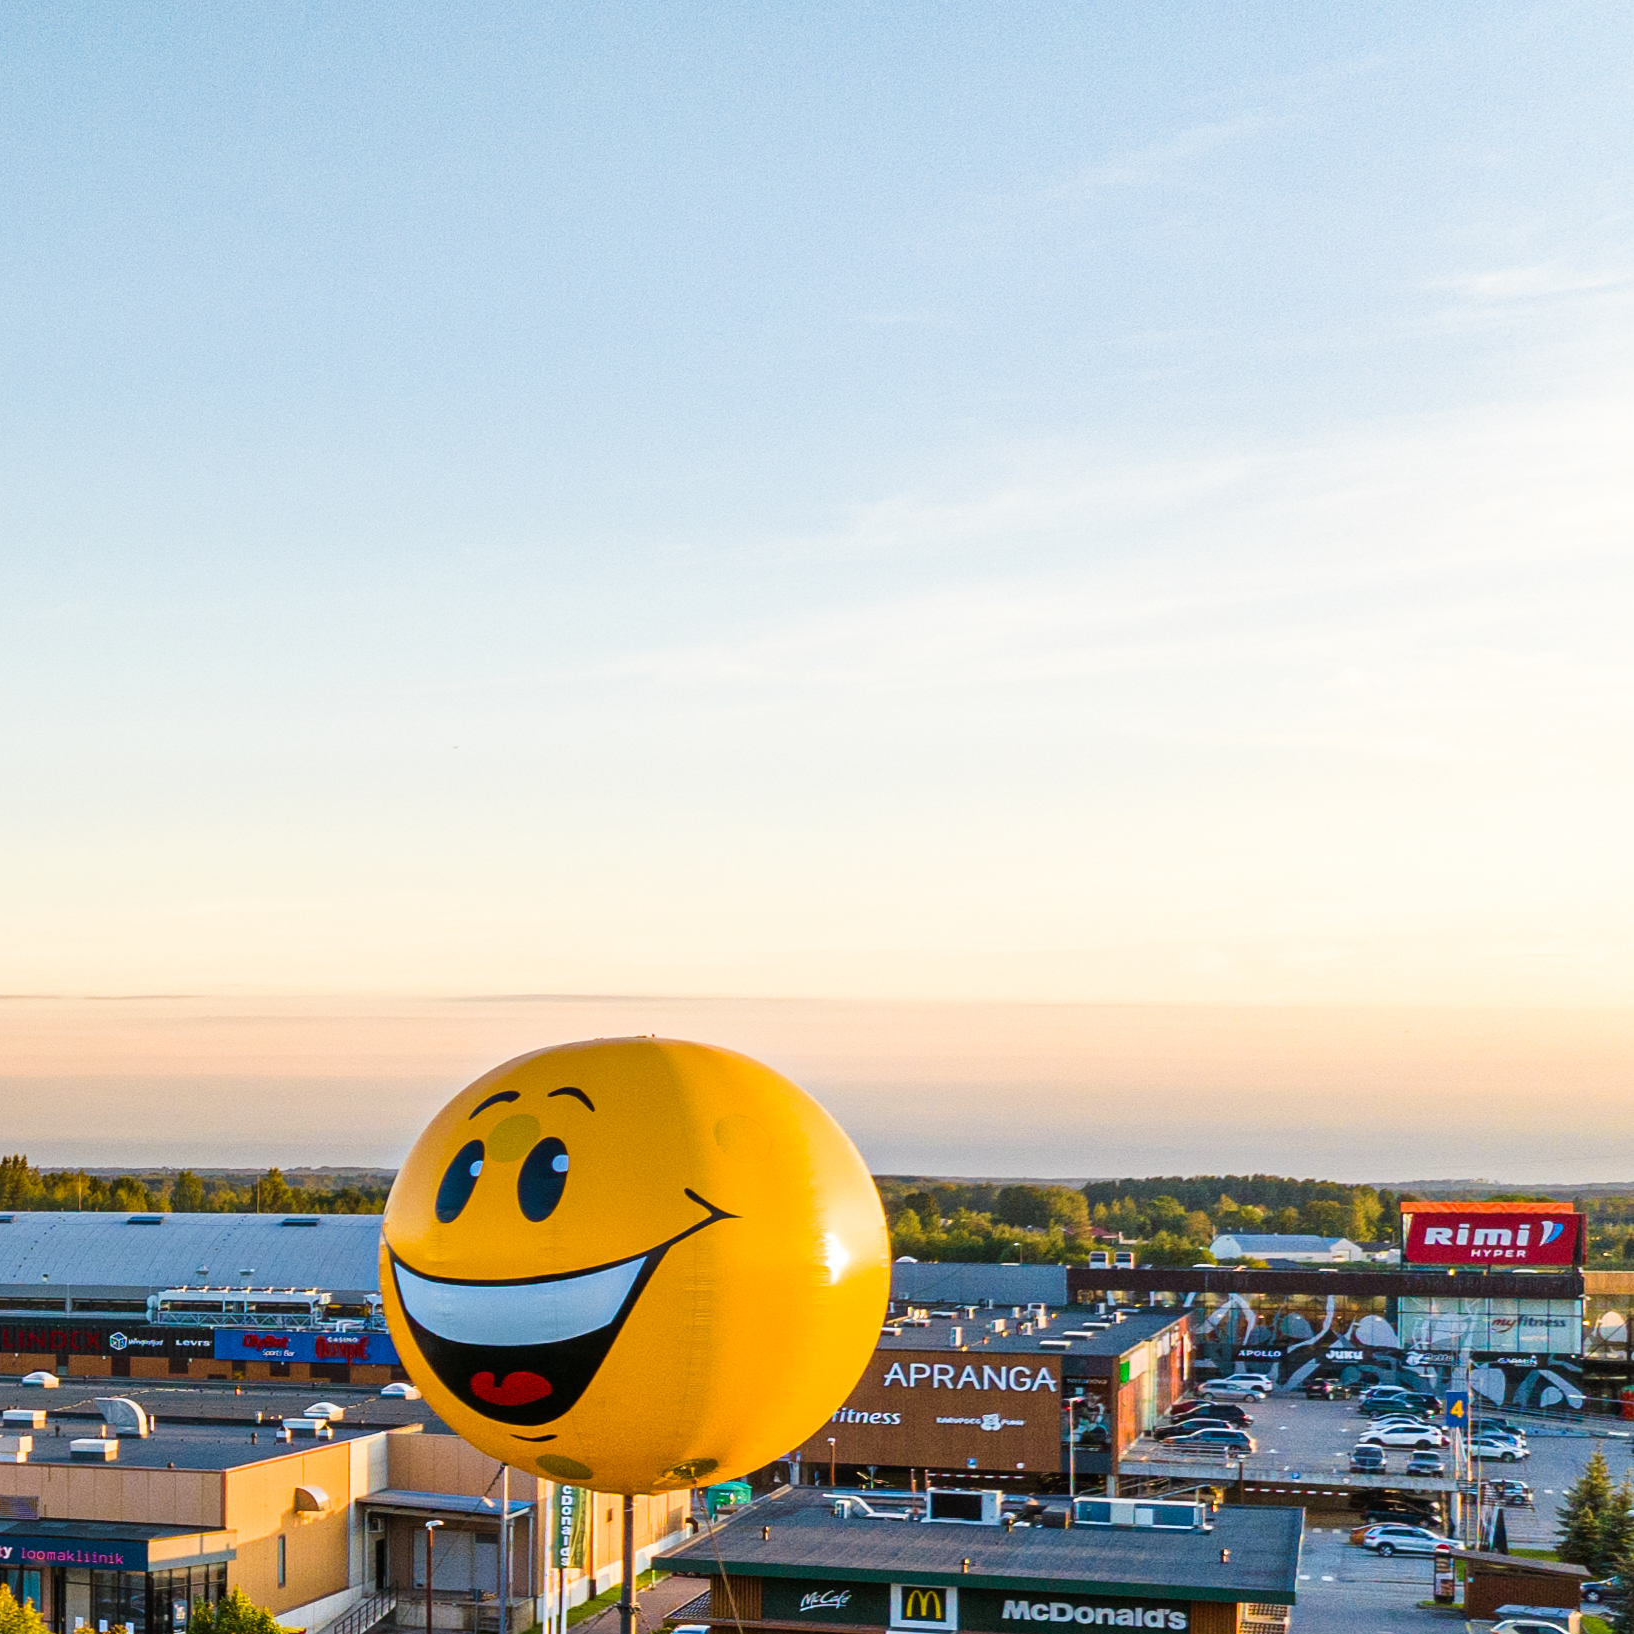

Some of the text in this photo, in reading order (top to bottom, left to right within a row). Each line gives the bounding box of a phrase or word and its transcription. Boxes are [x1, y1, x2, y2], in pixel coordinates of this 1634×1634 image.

[1423, 1223, 1531, 1247] Rimi
[1470, 1249, 1527, 1259] HYPER
[1238, 1349, 1282, 1358] APOLLO
[883, 1361, 1058, 1392] APRANGA
[1450, 1400, 1465, 1418] 4
[559, 1485, 574, 1567] cDonalds
[20, 1546, 125, 1566] loomakliinik
[1001, 1599, 1190, 1630] McDonald's
